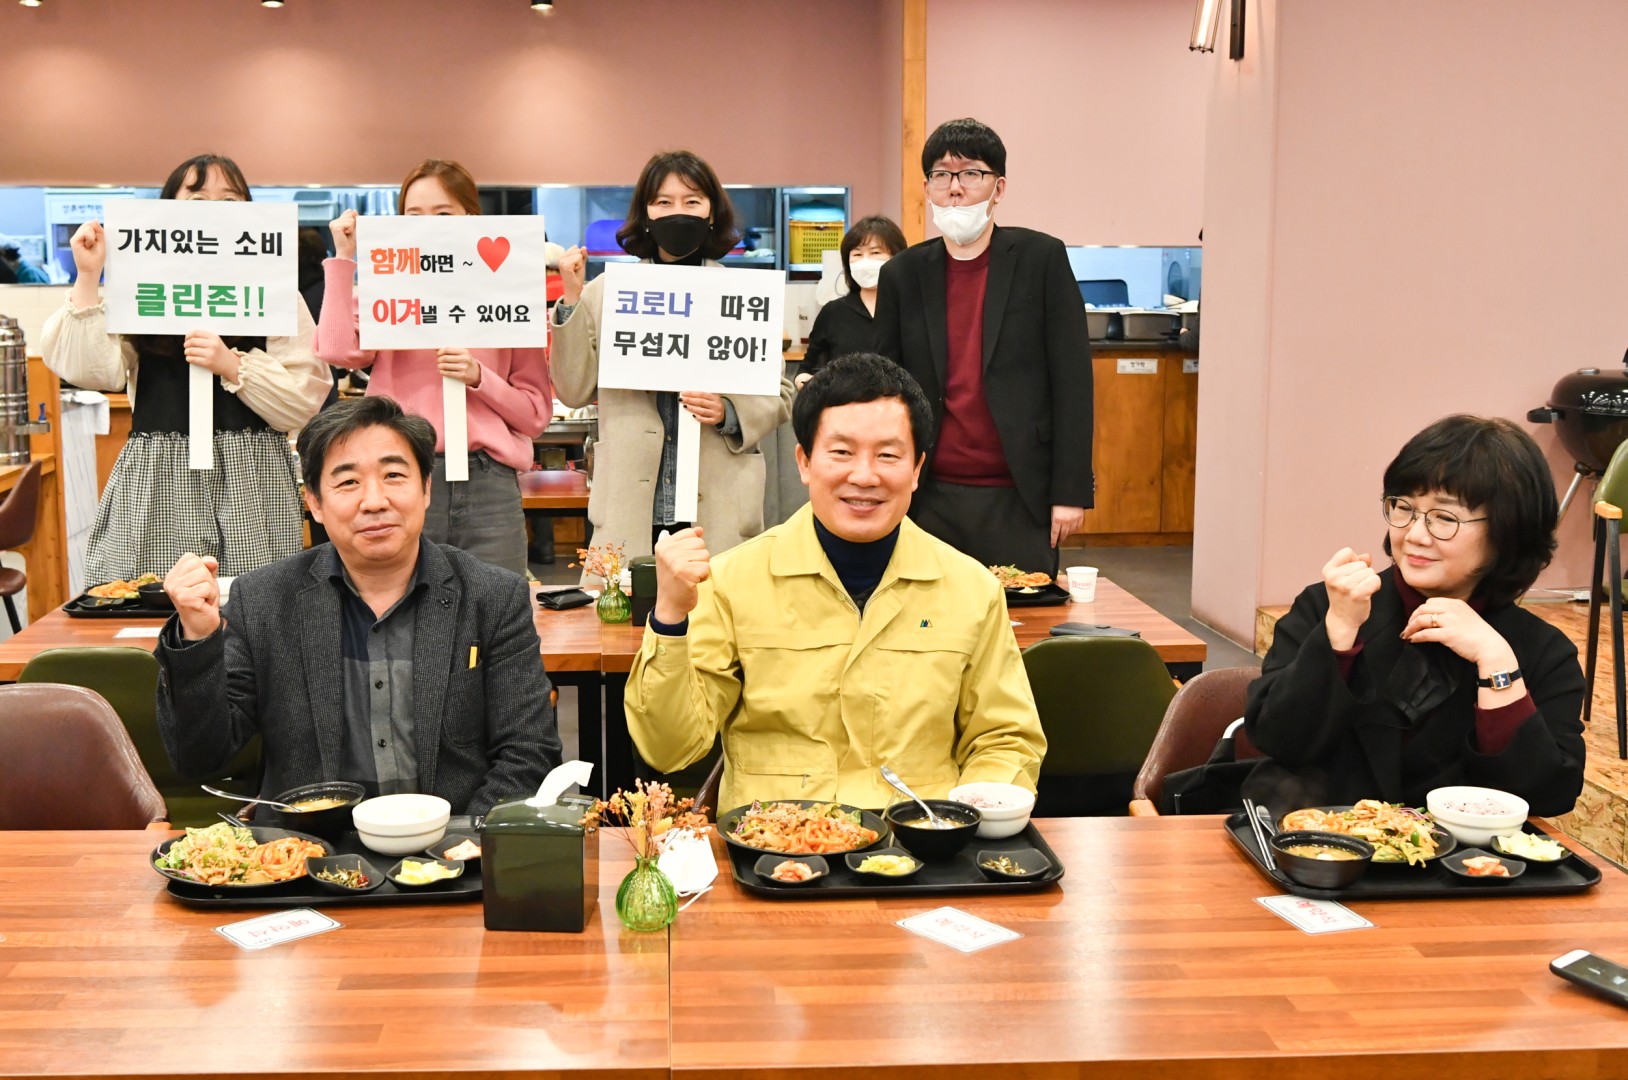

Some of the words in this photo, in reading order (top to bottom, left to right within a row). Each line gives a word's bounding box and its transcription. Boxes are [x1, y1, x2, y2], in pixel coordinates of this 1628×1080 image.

[117, 229, 219, 255] 가치있는
[235, 230, 283, 256] 소비
[370, 247, 453, 275] 함께하면
[135, 283, 265, 318] 클린존!!
[373, 298, 438, 325] 이겨낼
[449, 304, 467, 323] 수
[477, 304, 530, 323] 있어요
[615, 290, 693, 318] 코로나
[720, 295, 769, 321] 따위
[614, 331, 689, 360] 무섭지
[706, 335, 767, 362] 않아!
